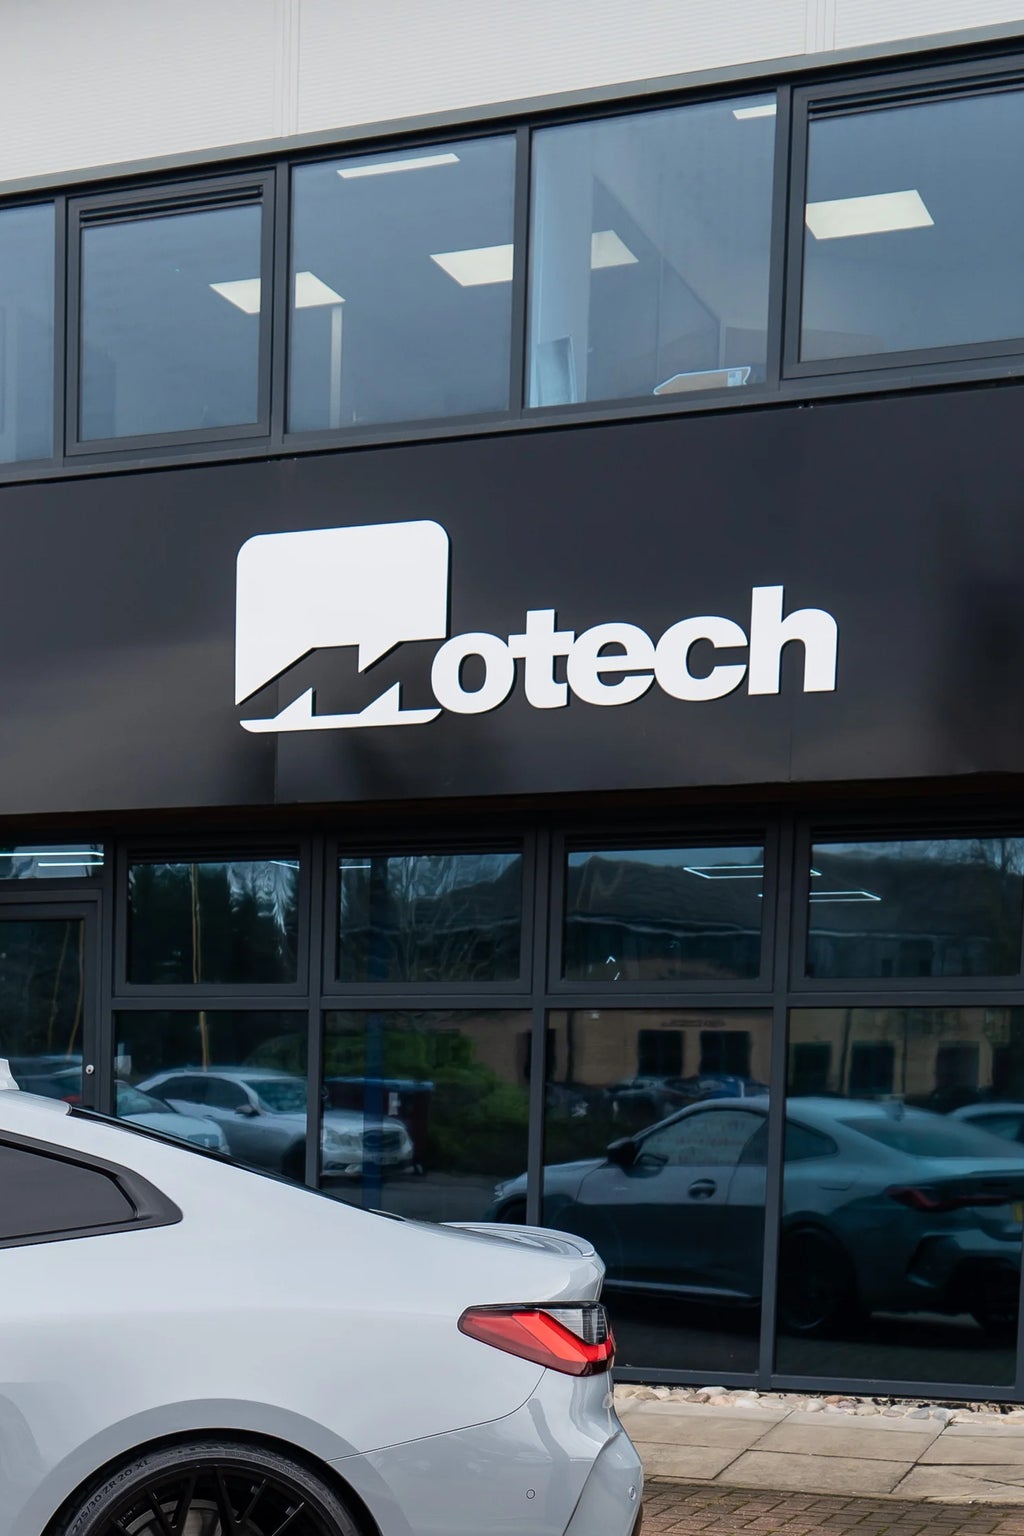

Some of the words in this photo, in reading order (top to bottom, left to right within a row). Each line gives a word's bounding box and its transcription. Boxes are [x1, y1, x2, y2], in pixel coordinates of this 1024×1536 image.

[71, 1494, 102, 1533] 275/30
[102, 1480, 117, 1495] ZR
[117, 1468, 133, 1481] 20
[135, 1460, 151, 1471] XL
